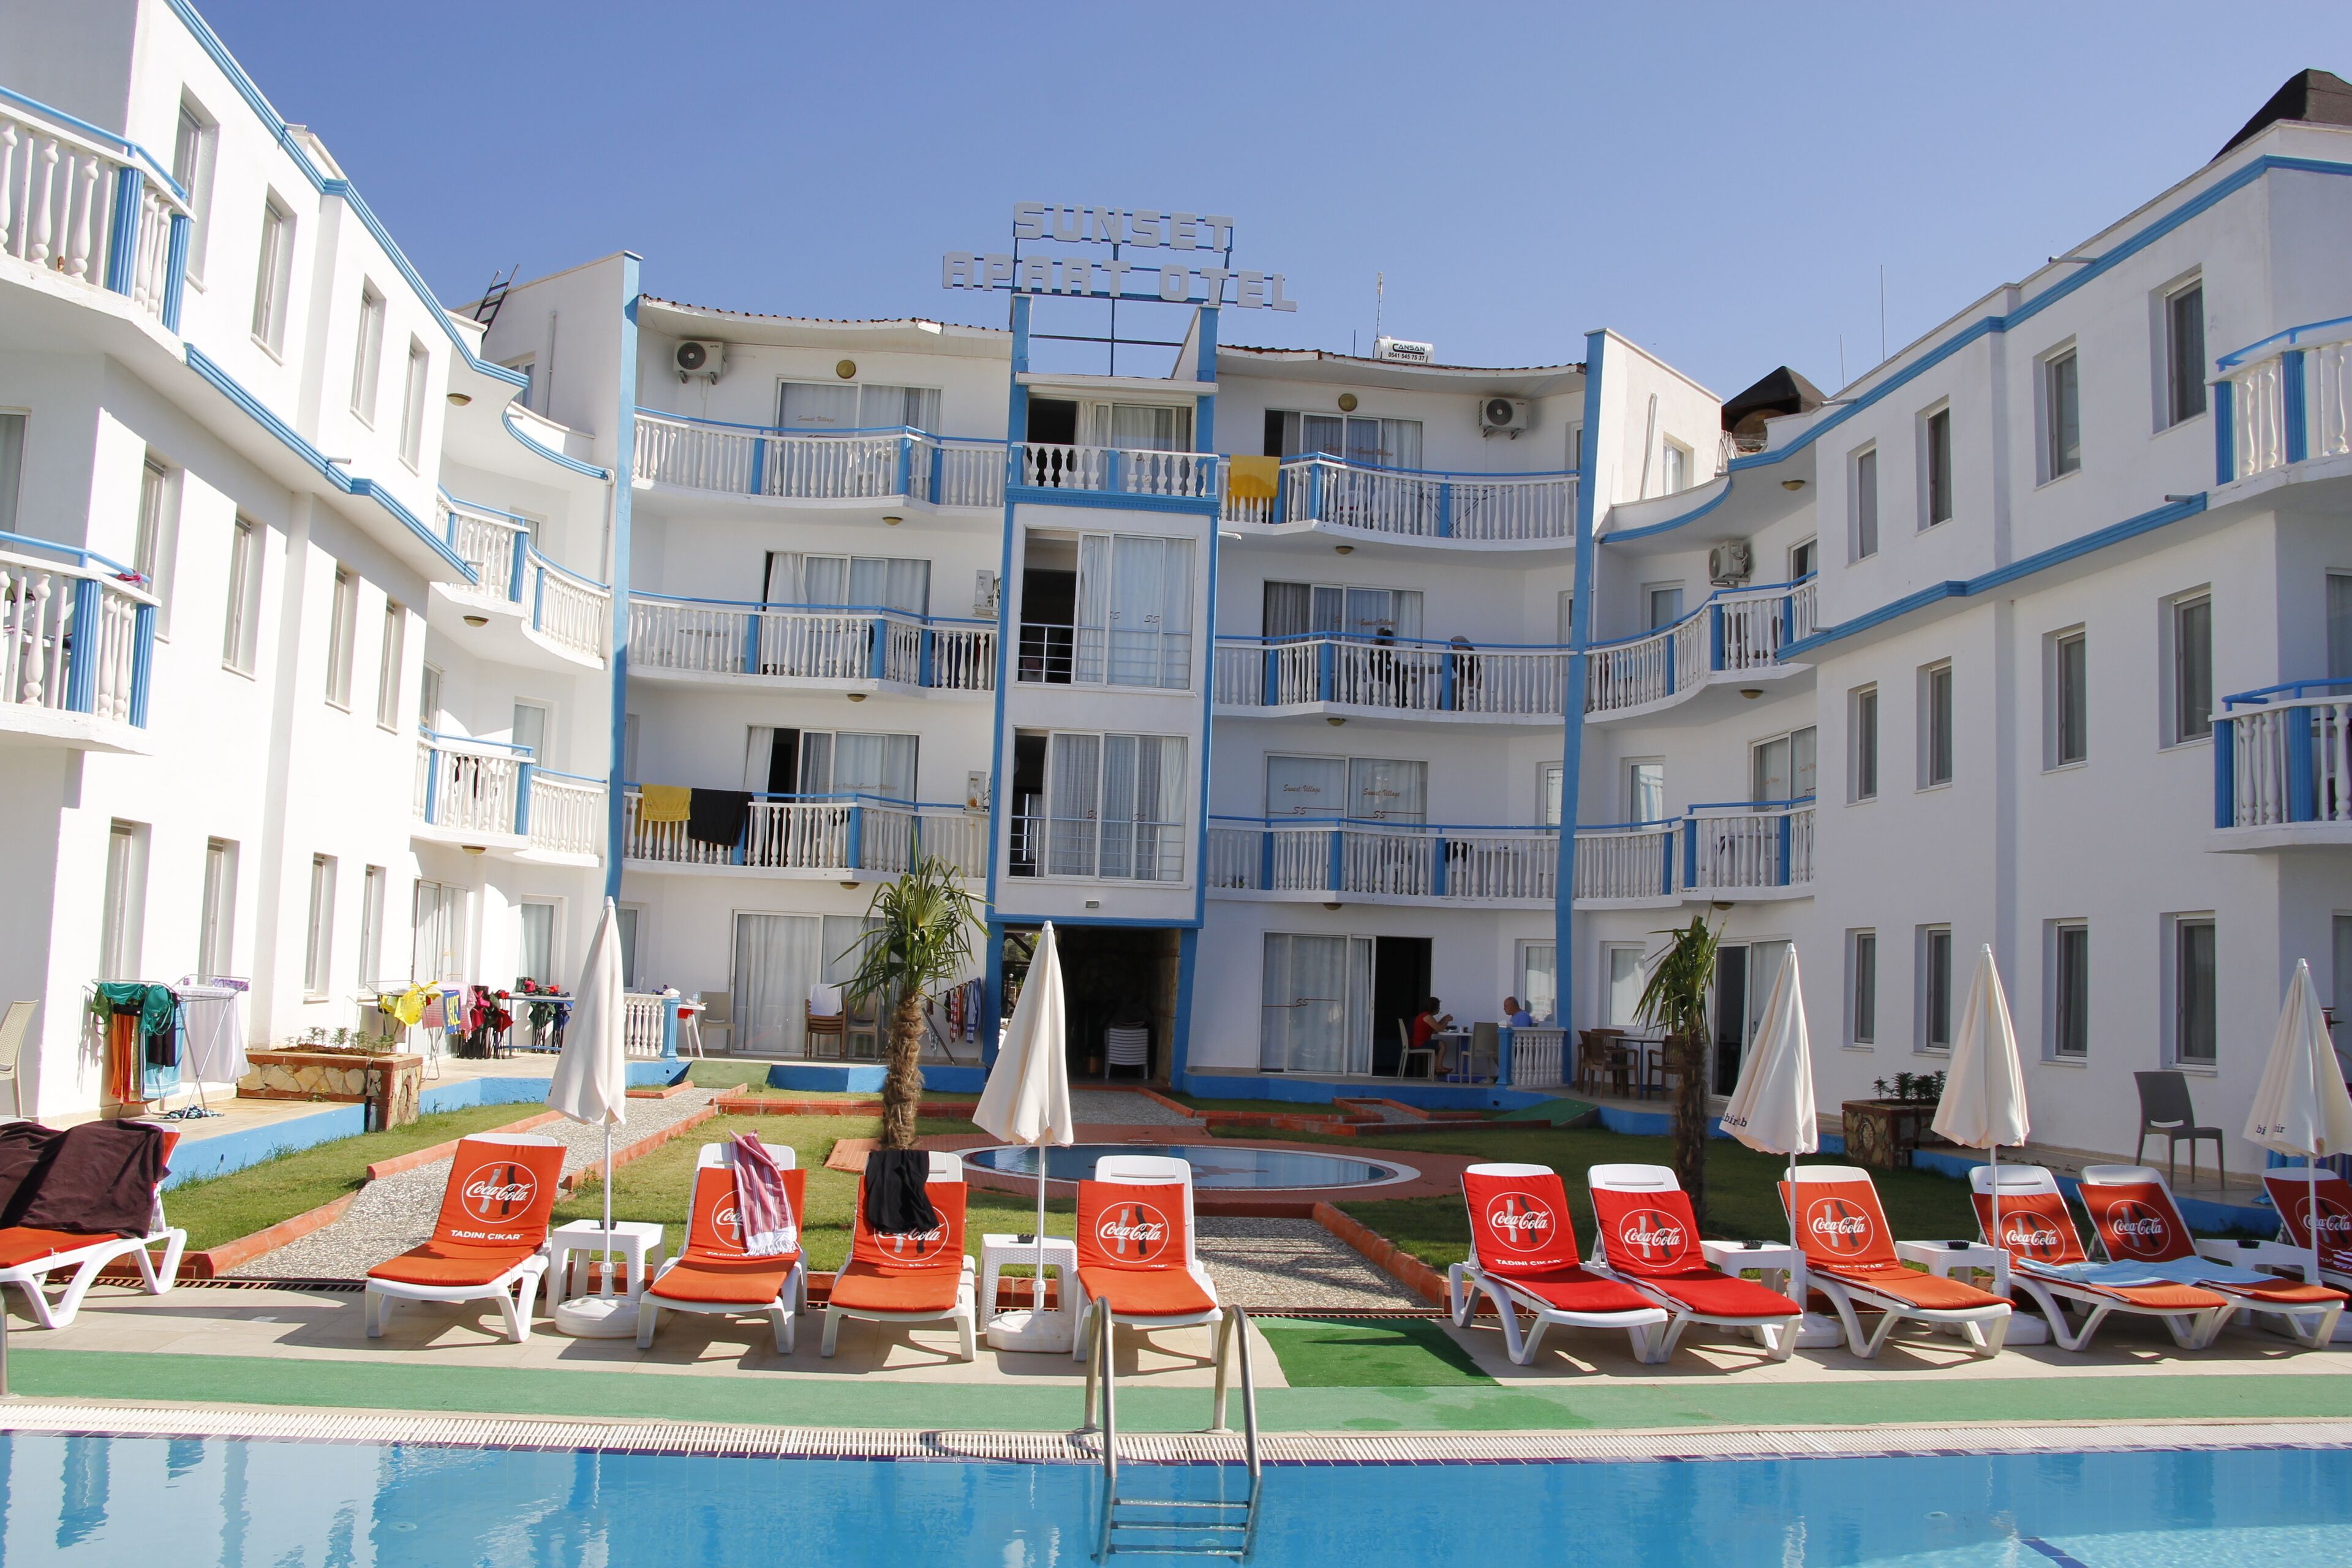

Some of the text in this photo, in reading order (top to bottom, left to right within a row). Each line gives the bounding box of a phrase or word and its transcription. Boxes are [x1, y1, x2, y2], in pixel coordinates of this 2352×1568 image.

[1014, 201, 1234, 253] SUNSET
[943, 251, 1297, 312] APART OTEL
[1392, 343, 1425, 354] CANSAN
[817, 416, 835, 424] Village
[1283, 784, 1321, 794] Sunset Village
[1363, 788, 1400, 799] Sunset Village
[466, 1180, 534, 1201] Coca-Cola
[1491, 1210, 1550, 1229] Coca-Cola
[1813, 1215, 1866, 1234] Coca-Cola
[2113, 1217, 2163, 1235] Coca-Cola
[451, 1229, 485, 1239] TADINI
[1100, 1221, 1165, 1240] Coca-Cola
[1624, 1227, 1681, 1246] Coca-Cola
[2006, 1229, 2057, 1246] Coca-Cola
